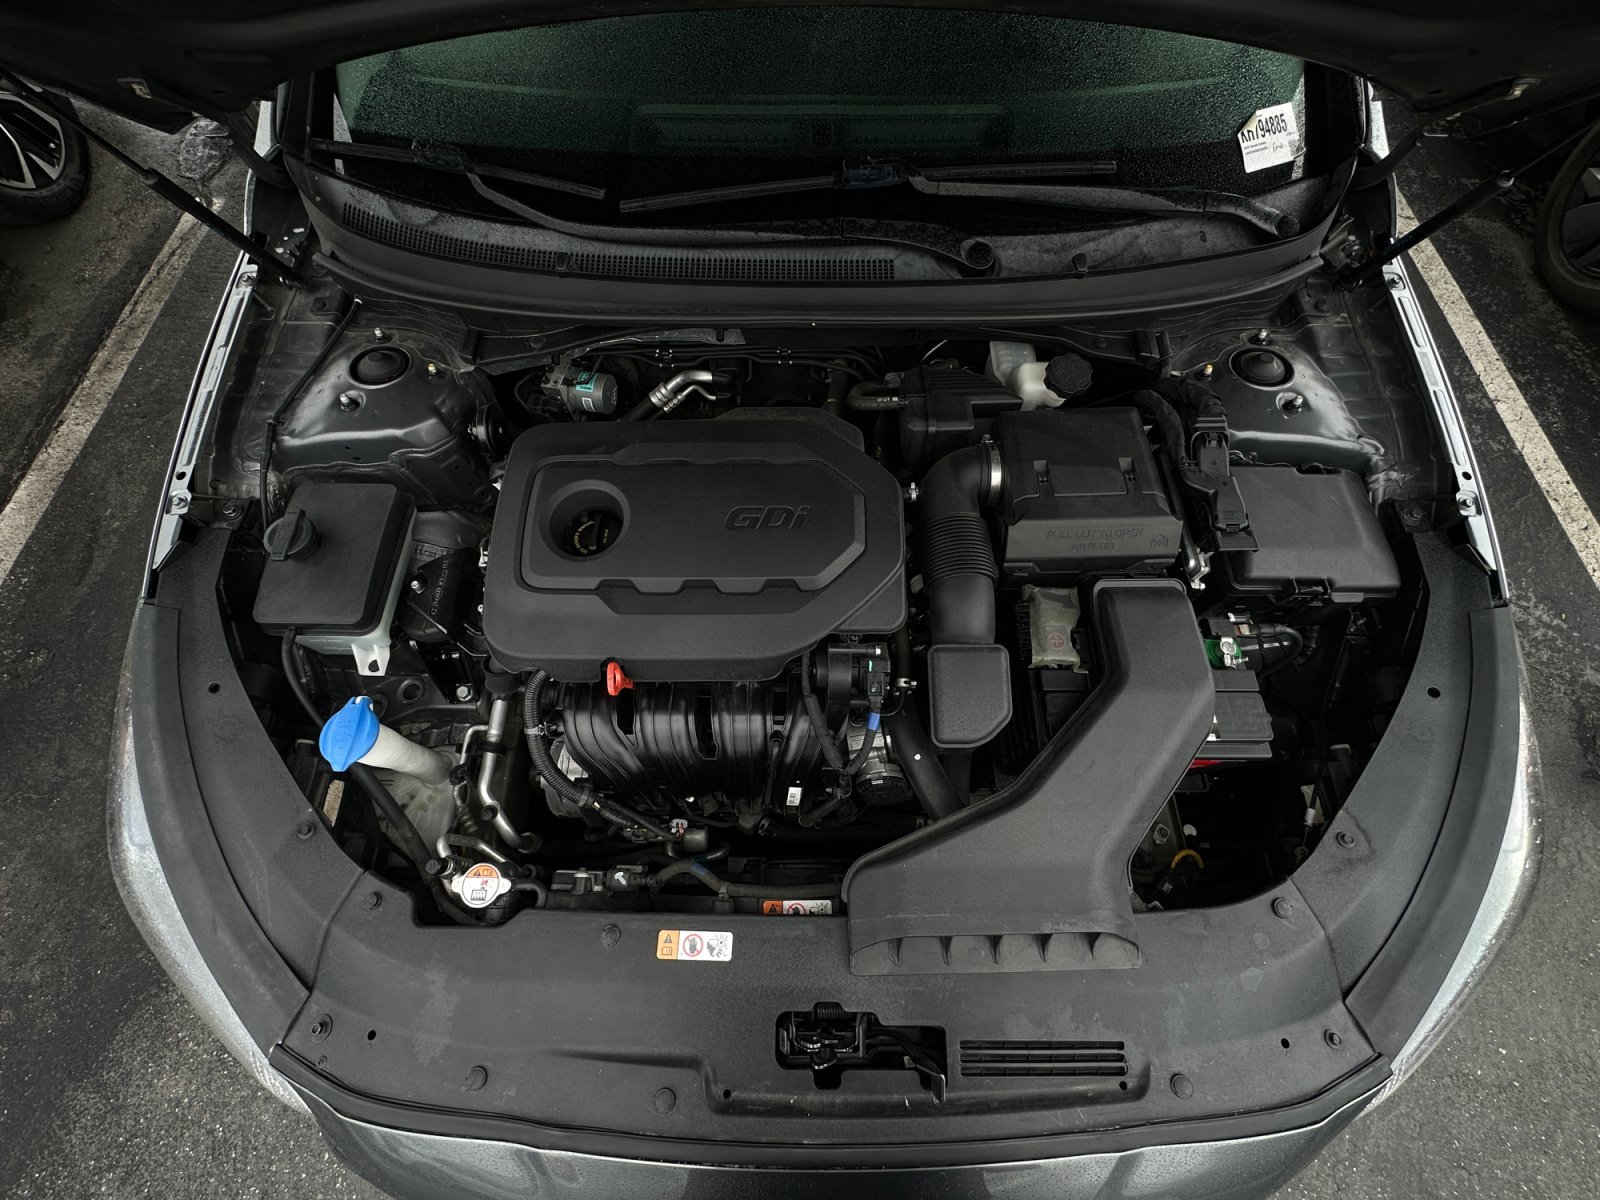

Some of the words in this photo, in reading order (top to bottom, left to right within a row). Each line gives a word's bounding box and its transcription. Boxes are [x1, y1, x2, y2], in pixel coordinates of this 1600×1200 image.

[1046, 529, 1072, 540] PULL
[1075, 528, 1096, 539] OUT
[1099, 527, 1113, 538] TO
[1115, 527, 1144, 538] OPEN
